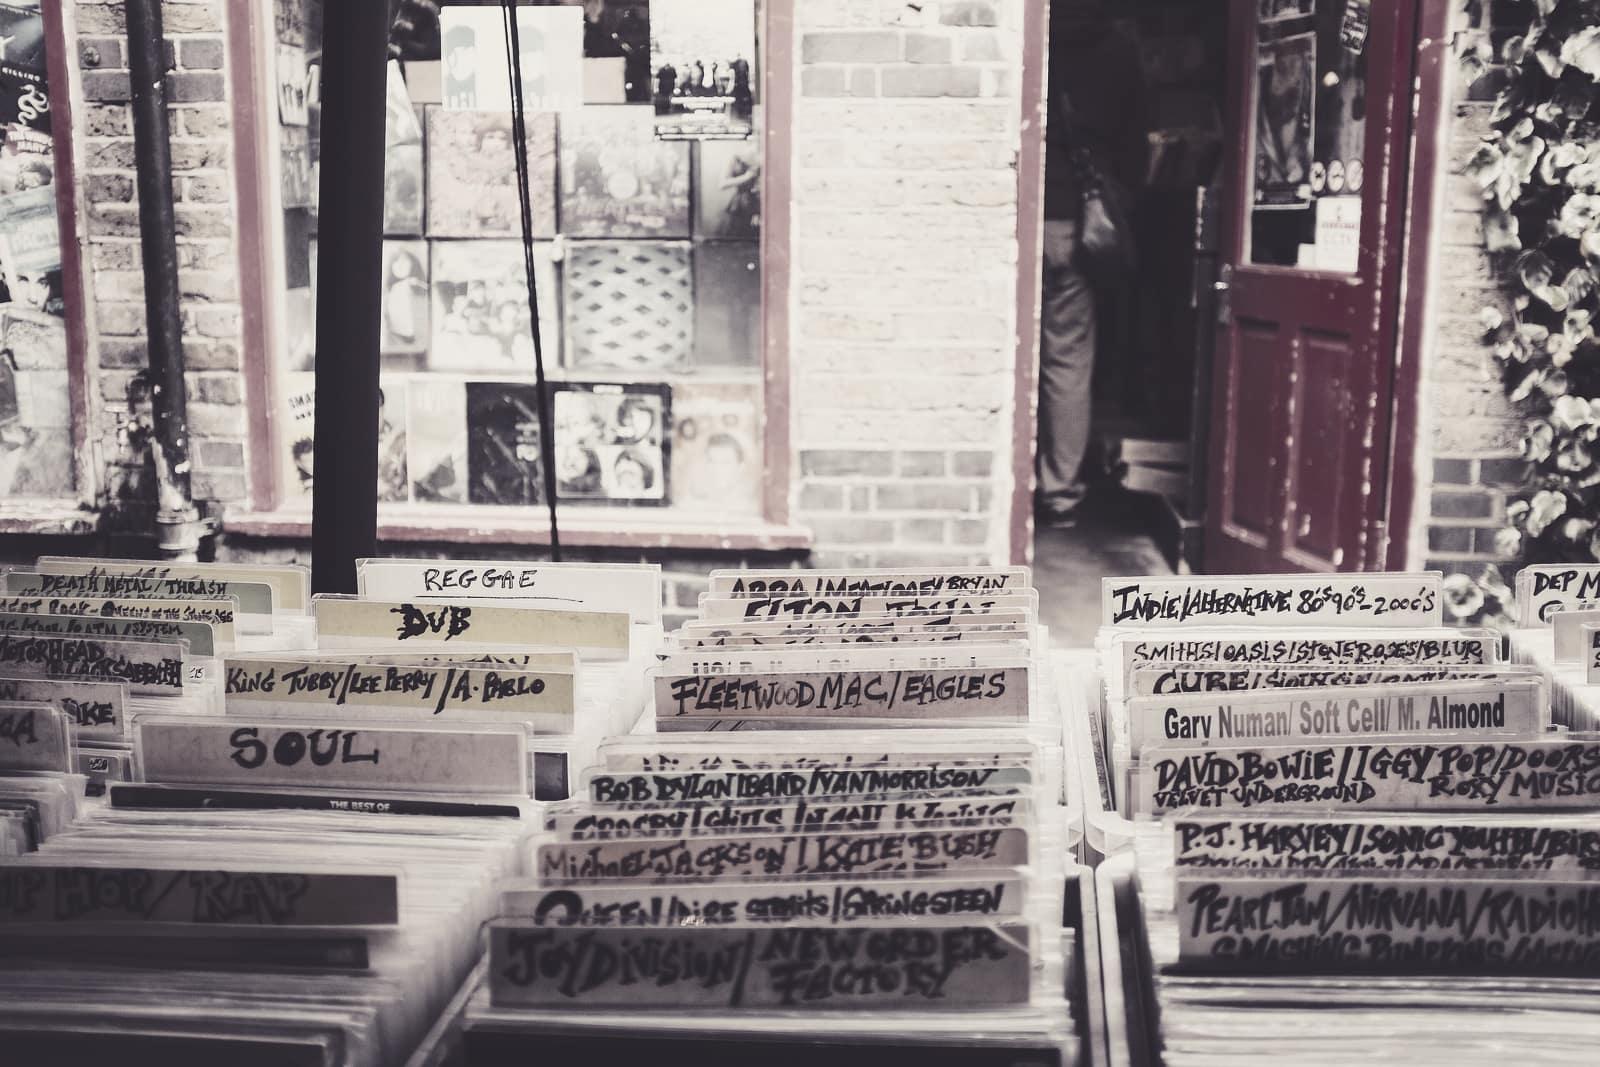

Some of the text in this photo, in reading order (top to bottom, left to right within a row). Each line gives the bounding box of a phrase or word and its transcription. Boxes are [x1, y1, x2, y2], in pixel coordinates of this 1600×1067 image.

[41, 574, 99, 593] DEATH
[104, 576, 152, 594] METAL
[165, 579, 227, 596] THRASH
[424, 568, 537, 591] REGGAE
[1534, 571, 1578, 596] DEP
[390, 604, 472, 641] DUB
[225, 667, 276, 694] KING
[482, 672, 545, 703] PABLO
[670, 675, 815, 717] FLEETWOOD
[1164, 707, 1212, 740] Gary
[1299, 701, 1343, 735] Soft
[1399, 698, 1422, 730] M.
[1426, 692, 1505, 729] Almond
[230, 727, 379, 769] SOUL
[590, 774, 652, 802] BOB
[868, 765, 999, 794] MORRISON
[1153, 755, 1238, 792] DAVID
[1427, 772, 1600, 803] ROXY MUSIC
[330, 800, 391, 812] THE BEST OF
[1153, 780, 1376, 807] VELVET UNDERGROUND
[649, 837, 786, 876] JACKSON
[816, 832, 905, 871] KATE
[909, 829, 1003, 861] BUSH
[1176, 822, 1236, 853] P.J.
[1187, 883, 1278, 938] PEARL
[759, 927, 860, 963] NEW
[863, 927, 1008, 963] ORDER
[768, 963, 953, 1002] FACTORY
